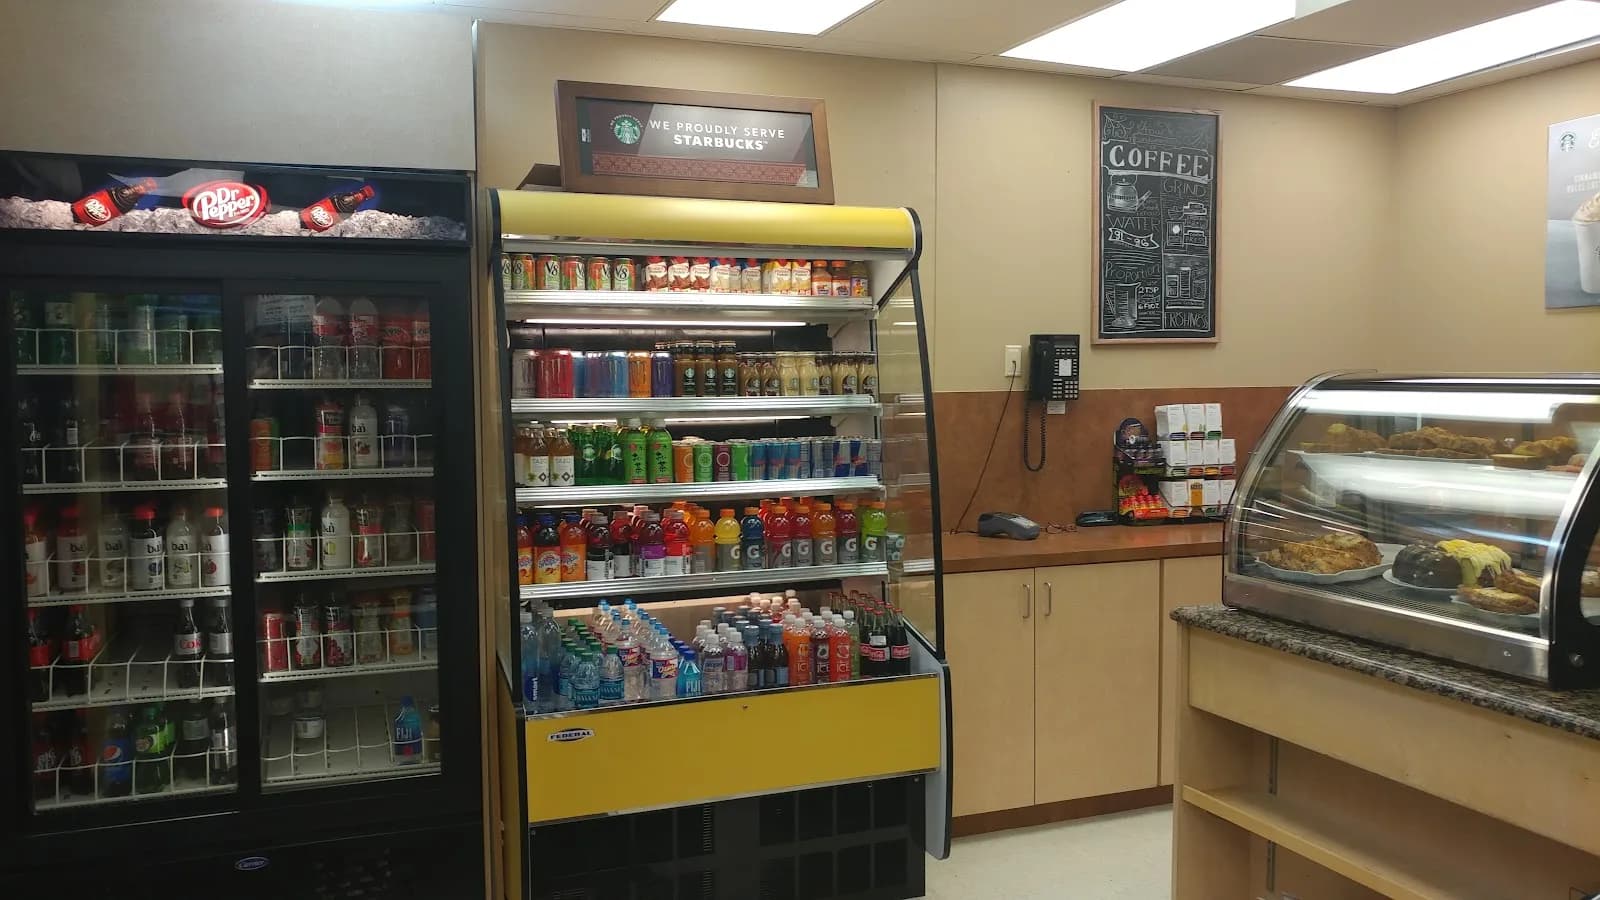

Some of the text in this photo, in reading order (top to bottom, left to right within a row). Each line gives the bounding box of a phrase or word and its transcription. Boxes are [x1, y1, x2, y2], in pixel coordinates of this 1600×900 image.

[649, 119, 670, 130] WE
[676, 121, 738, 136] PROUDLY
[744, 126, 786, 139] SERVE
[1109, 145, 1209, 180] COFFEE
[216, 187, 240, 203] Dr
[1163, 177, 1207, 198] GRIND
[200, 190, 255, 221] Pepper
[1105, 214, 1162, 233] WATER
[1114, 229, 1125, 241] 91
[1134, 238, 1150, 248] 96
[545, 261, 559, 276] V8
[614, 264, 628, 280] V8
[747, 544, 760, 559] G
[781, 542, 793, 558] G
[797, 541, 810, 556] G
[820, 540, 833, 556] G
[845, 537, 857, 553] G
[865, 536, 878, 551] G
[730, 544, 741, 560] G
[836, 662, 851, 673] ICE
[685, 680, 702, 693] FIJI
[396, 727, 413, 741] FIJI
[549, 730, 592, 740] FEDERAL
